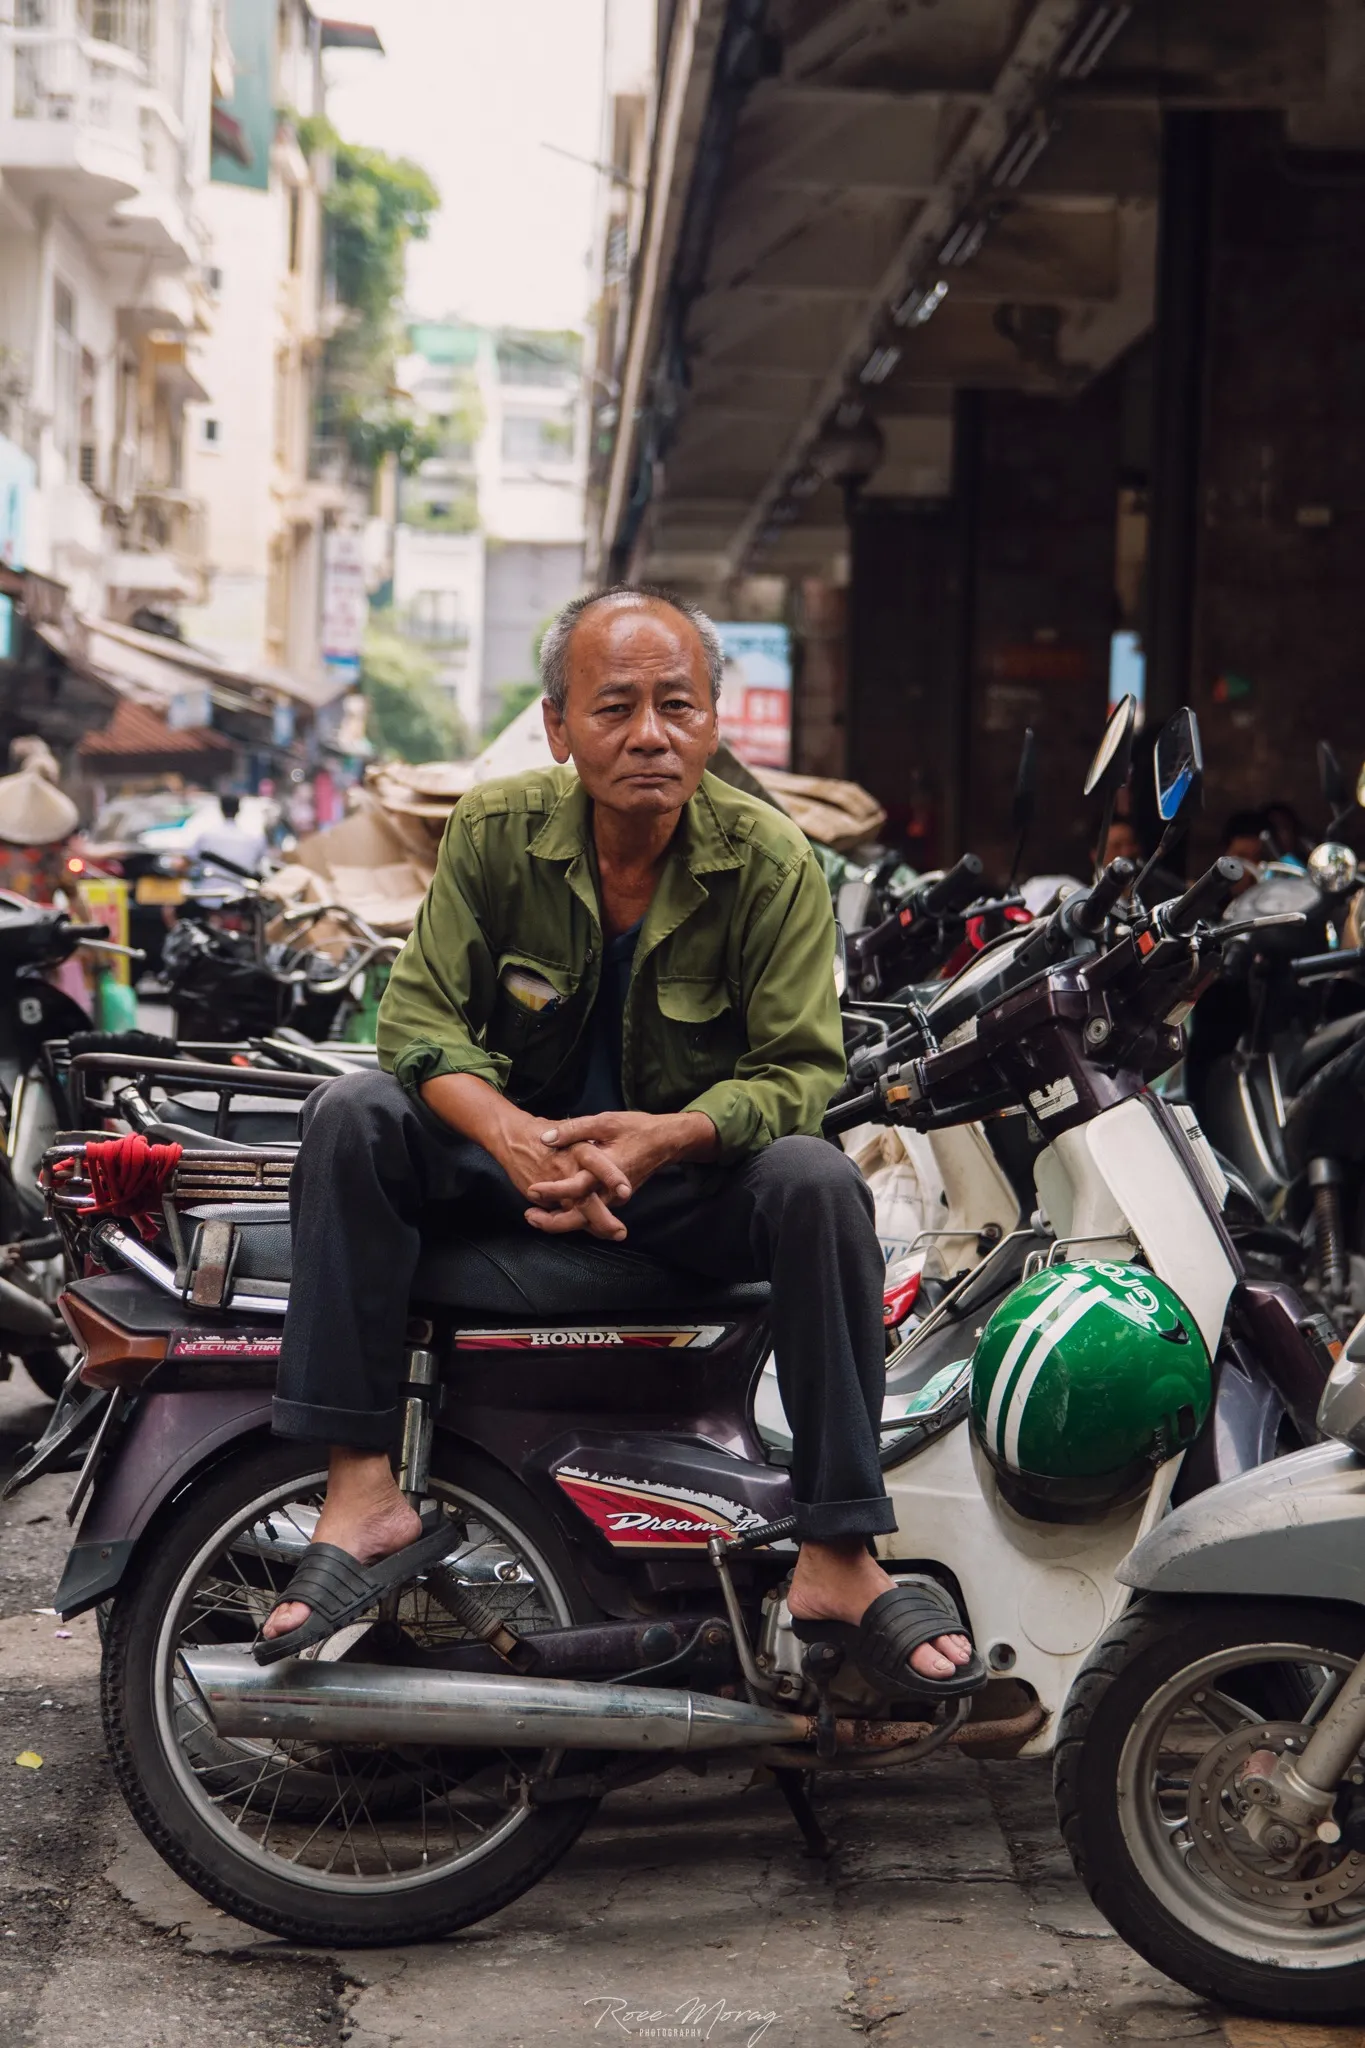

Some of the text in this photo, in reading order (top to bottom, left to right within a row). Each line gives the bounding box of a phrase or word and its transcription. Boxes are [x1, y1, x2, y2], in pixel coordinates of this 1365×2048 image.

[530, 1332, 624, 1345] HONDA
[184, 1343, 281, 1351] ELECTRIC START
[606, 1512, 729, 1531] Dream
